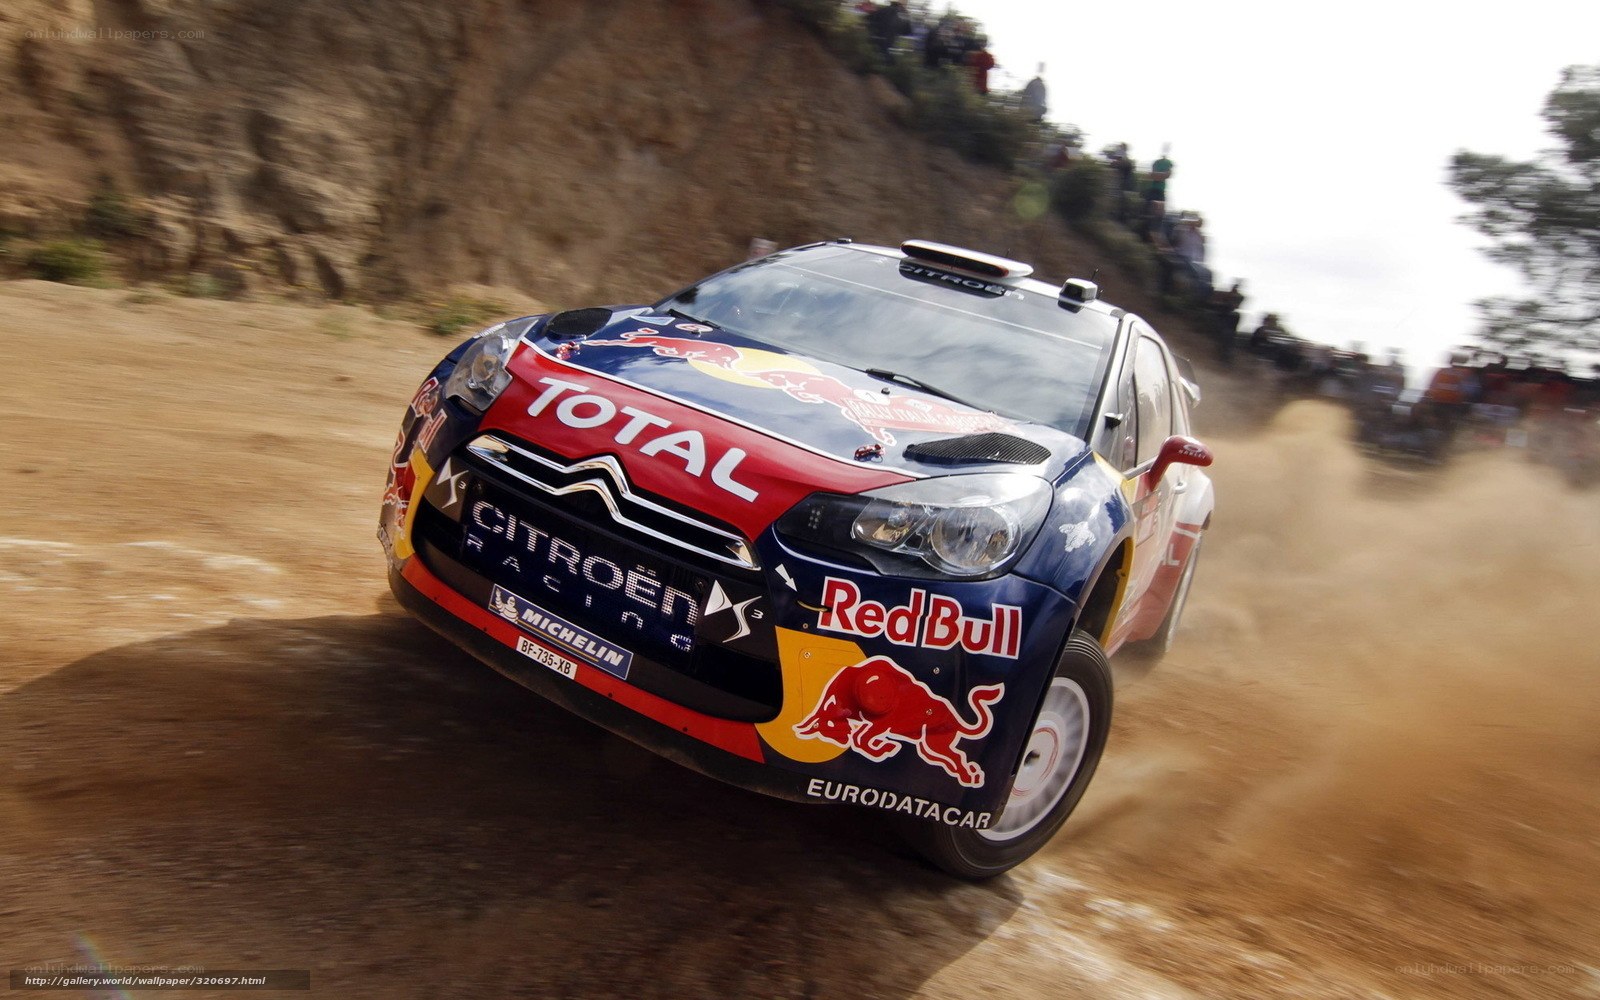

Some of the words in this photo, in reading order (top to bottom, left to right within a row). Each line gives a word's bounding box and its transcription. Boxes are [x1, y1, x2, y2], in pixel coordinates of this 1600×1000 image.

[527, 377, 759, 503] TOTAL
[520, 639, 572, 675] BF-735-XB
[521, 608, 624, 667] MICHELIN
[806, 778, 992, 829] EURODATACAR
